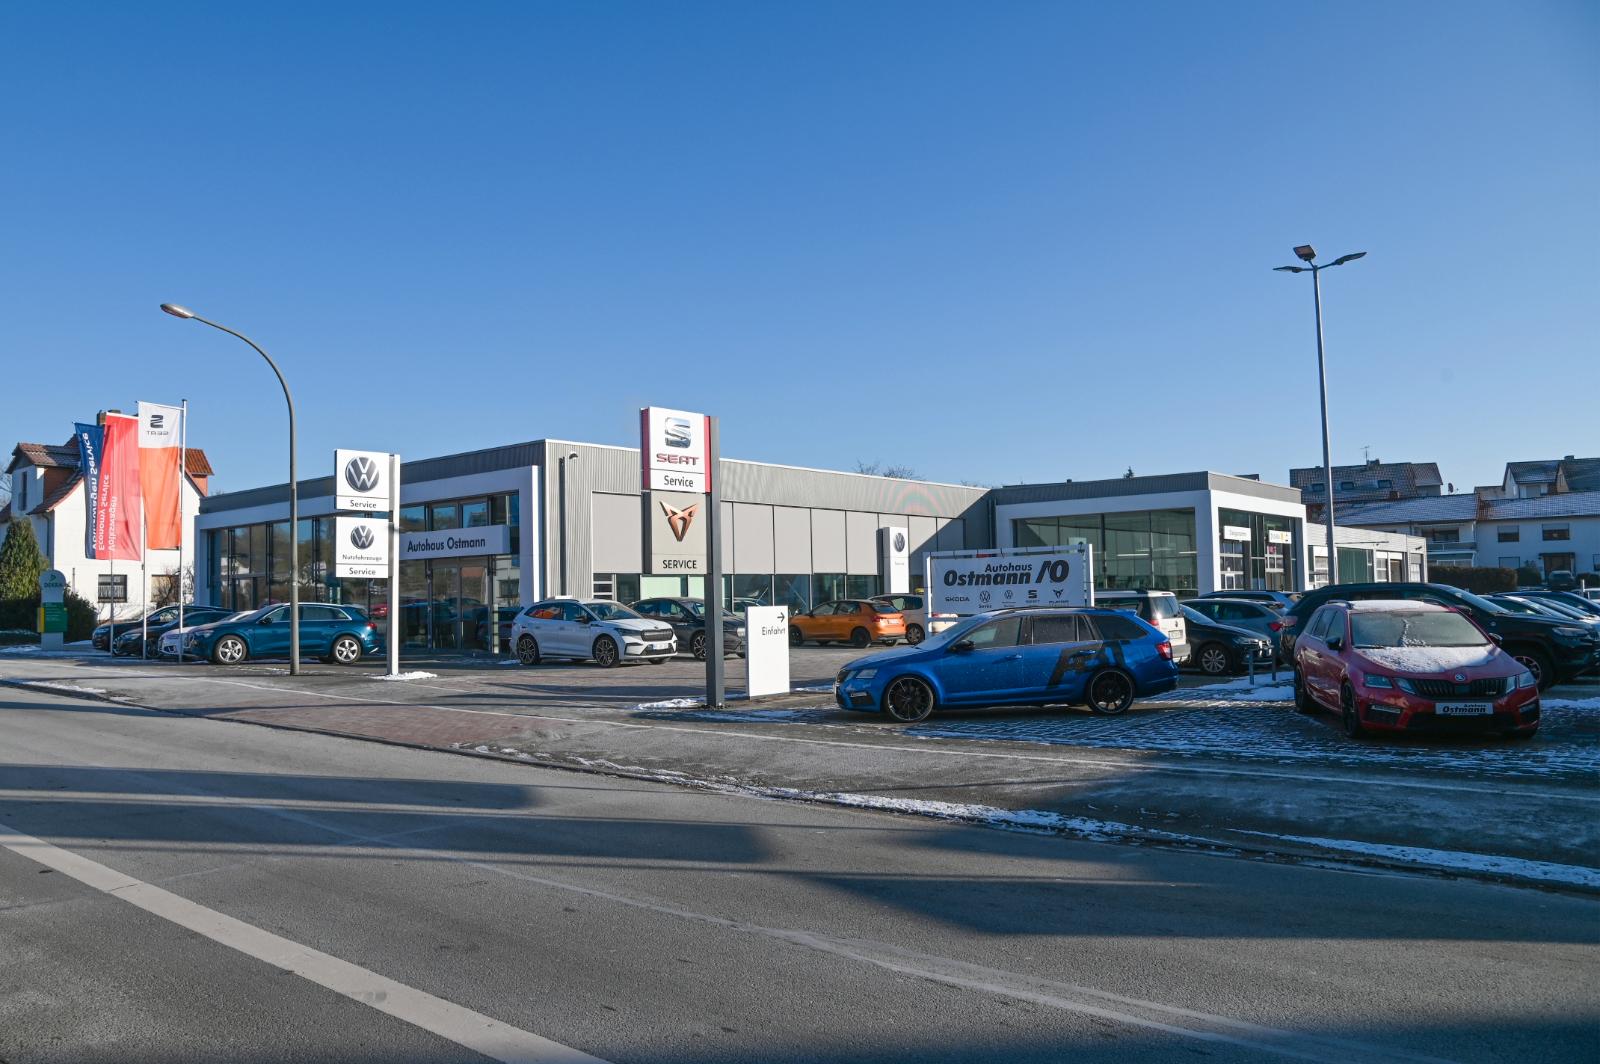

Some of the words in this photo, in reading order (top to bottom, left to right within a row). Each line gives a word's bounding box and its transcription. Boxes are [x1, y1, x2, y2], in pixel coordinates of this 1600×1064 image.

[656, 453, 699, 466] SEAT
[664, 475, 694, 488] Service
[350, 500, 377, 509] Service
[407, 538, 445, 552] Autohaus
[446, 536, 486, 550] Ostmann
[662, 559, 697, 570] SERVICE
[985, 562, 1033, 573] Autohaus
[349, 568, 376, 576] Service
[943, 569, 1032, 587] Ostmann
[761, 625, 786, 636] Einfahrt
[1442, 705, 1486, 714] Ostmann
